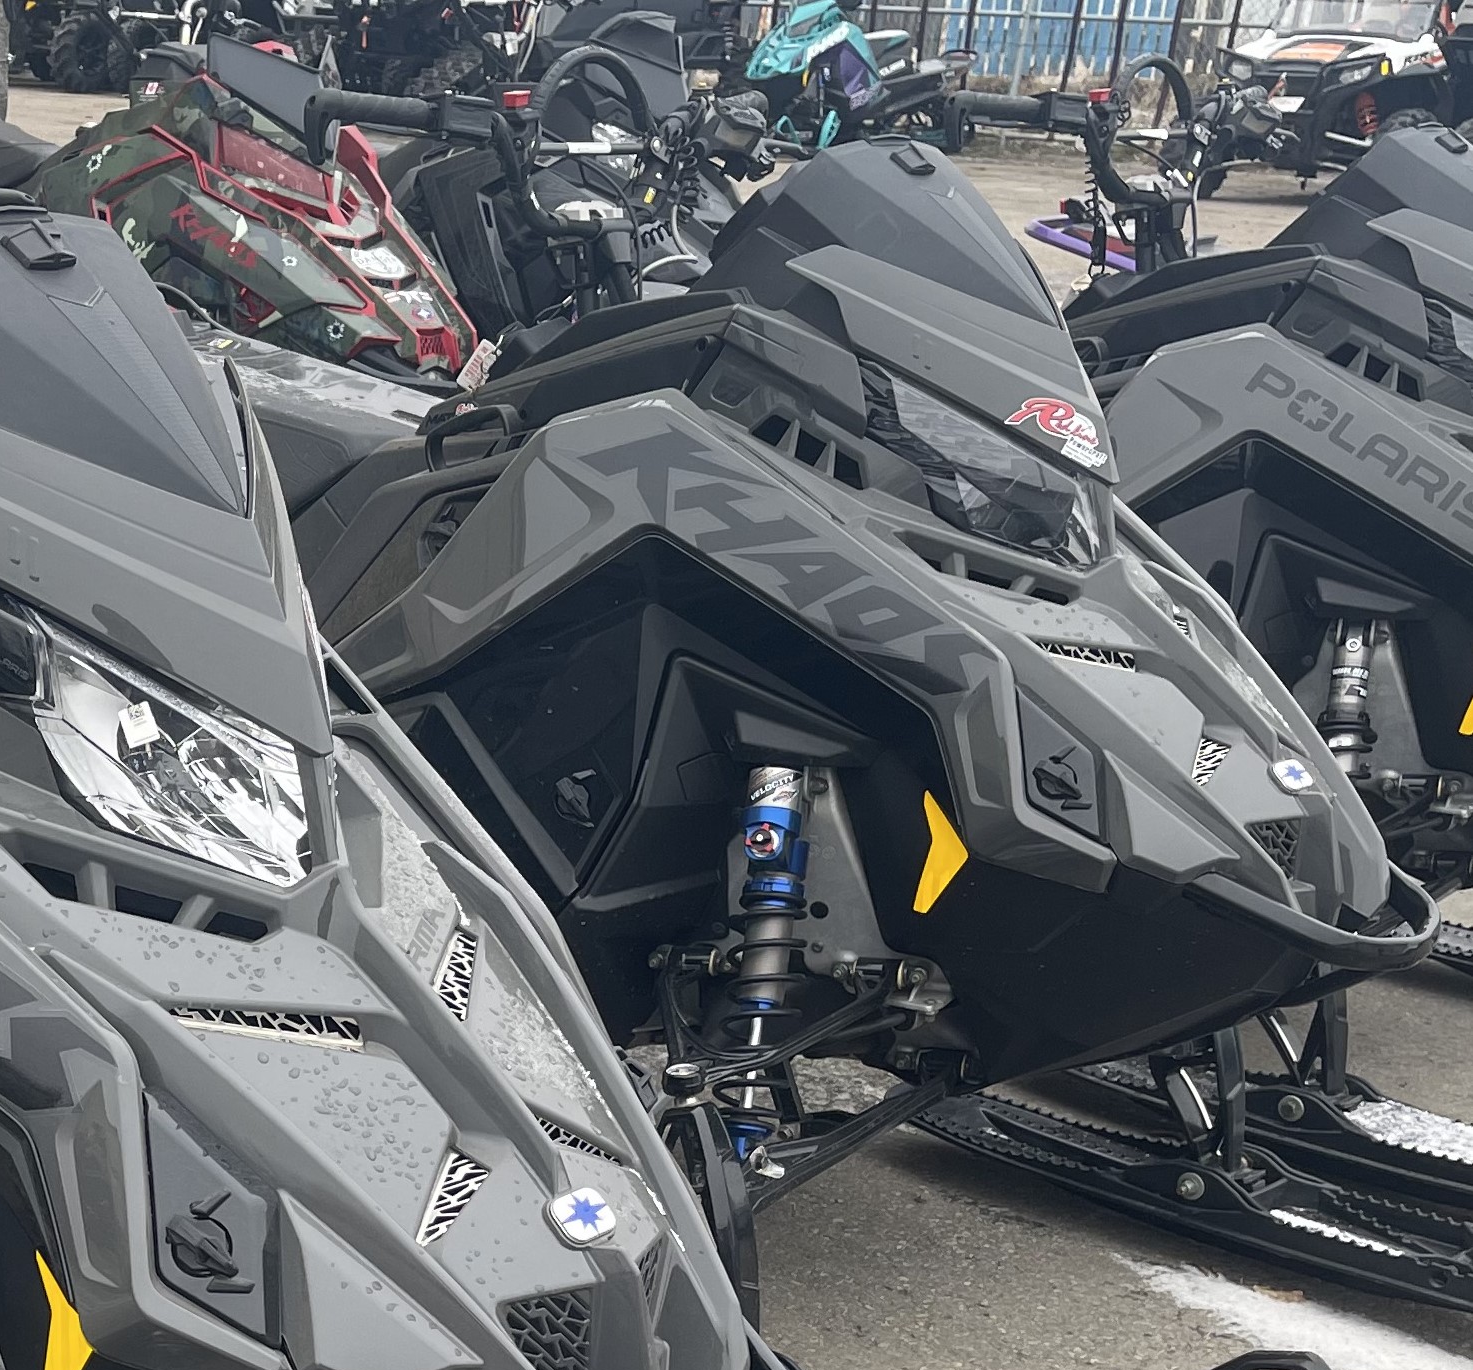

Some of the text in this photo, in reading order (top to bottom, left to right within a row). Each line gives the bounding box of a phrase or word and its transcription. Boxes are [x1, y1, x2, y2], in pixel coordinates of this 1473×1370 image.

[1244, 362, 1473, 530] POLARIS
[577, 424, 1002, 696] KHAOS
[750, 773, 794, 801] VELOCITY
